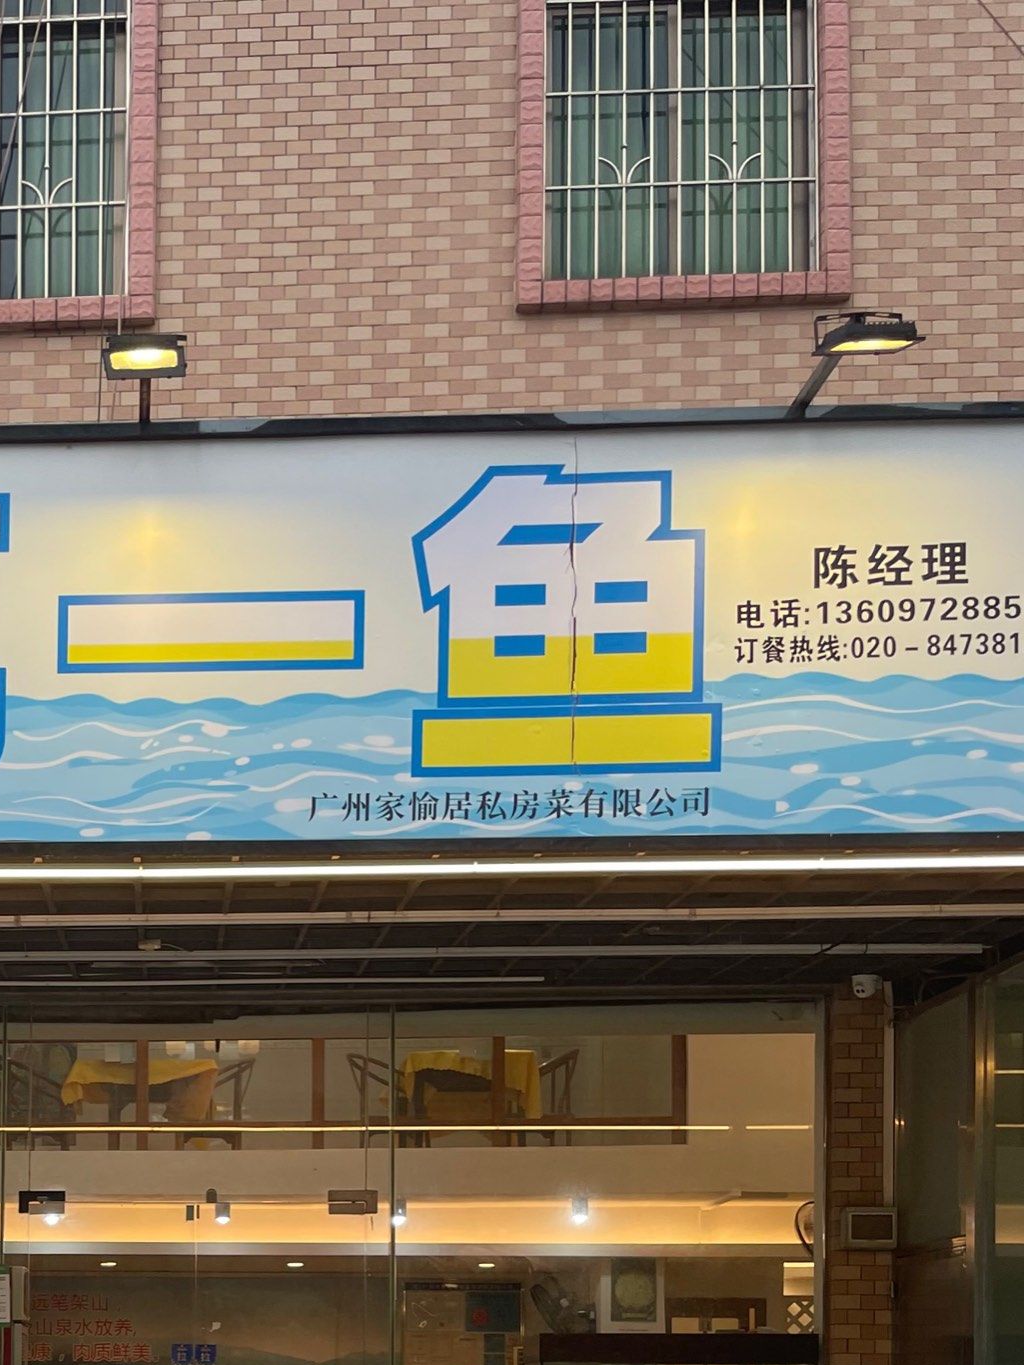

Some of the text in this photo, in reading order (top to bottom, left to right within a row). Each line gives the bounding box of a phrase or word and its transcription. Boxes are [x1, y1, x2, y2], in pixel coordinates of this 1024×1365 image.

[813, 541, 970, 588] 陈经理
[736, 595, 1021, 629] 电话:1360972885
[308, 786, 712, 823] 广州家愉居私房菜有限公司
